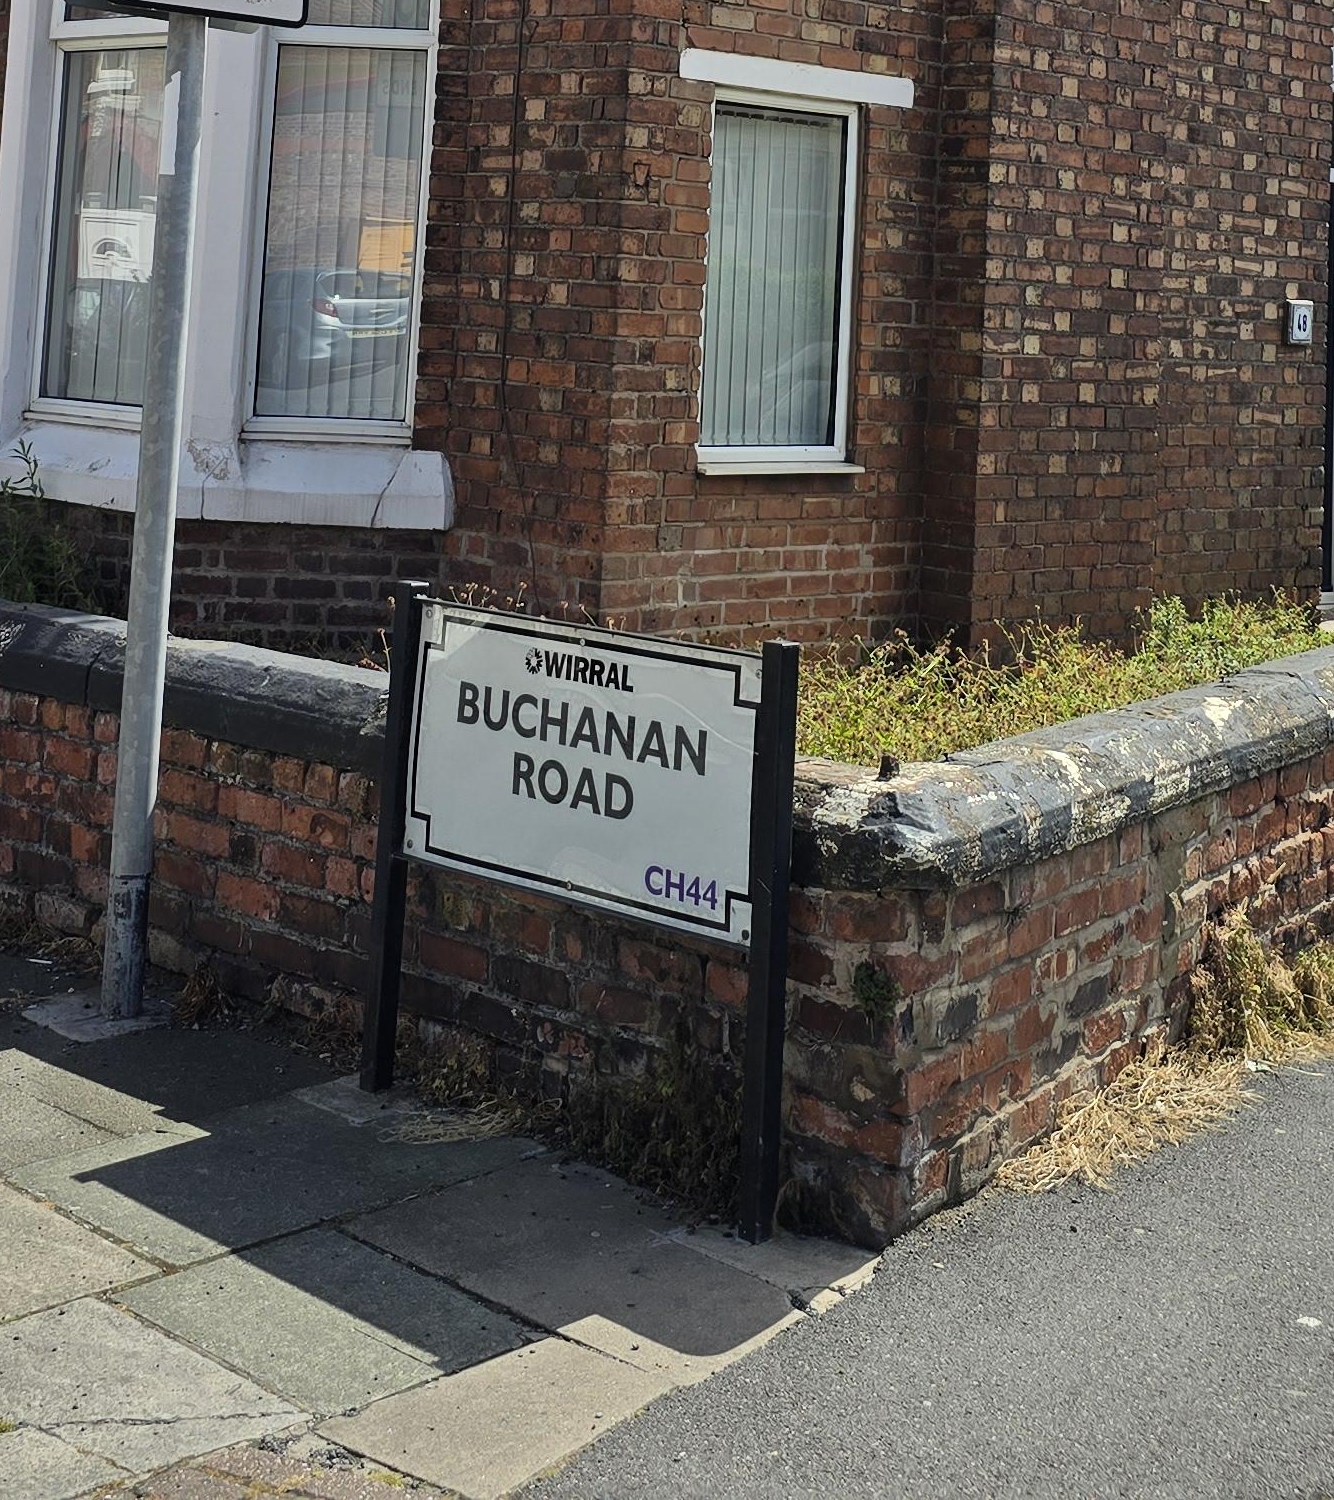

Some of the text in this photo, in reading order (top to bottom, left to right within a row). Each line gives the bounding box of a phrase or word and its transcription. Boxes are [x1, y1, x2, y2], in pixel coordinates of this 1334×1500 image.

[544, 650, 634, 693] WIRRAL
[456, 680, 708, 776] BUCHANAN
[511, 751, 634, 821] ROAD
[644, 865, 718, 910] CH44
